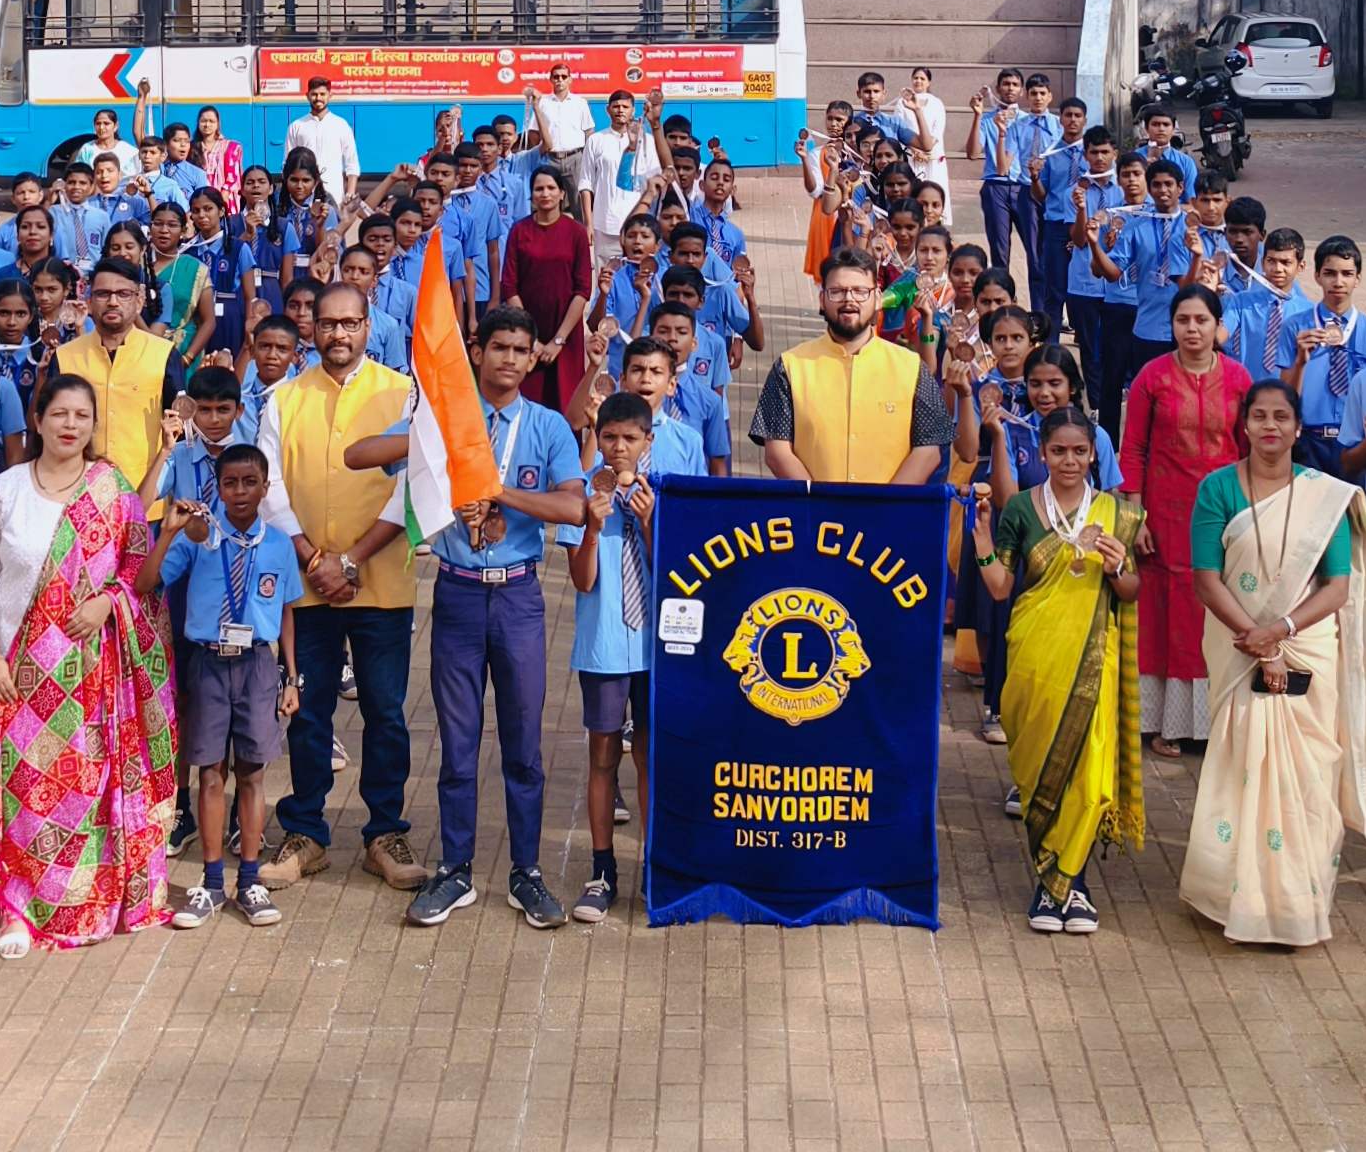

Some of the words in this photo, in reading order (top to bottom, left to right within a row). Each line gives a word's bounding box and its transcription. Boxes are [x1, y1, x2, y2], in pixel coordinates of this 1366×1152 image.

[668, 516, 794, 596] LIONS
[816, 521, 928, 608] CLUB
[758, 594, 840, 625] LIONS
[781, 632, 818, 679] L
[756, 686, 833, 711] INTERNATIONAL
[714, 761, 874, 793] CURCHOREM
[713, 792, 870, 822] SANVORDEM
[735, 829, 784, 848] DIST.
[791, 830, 847, 850] 317-B
